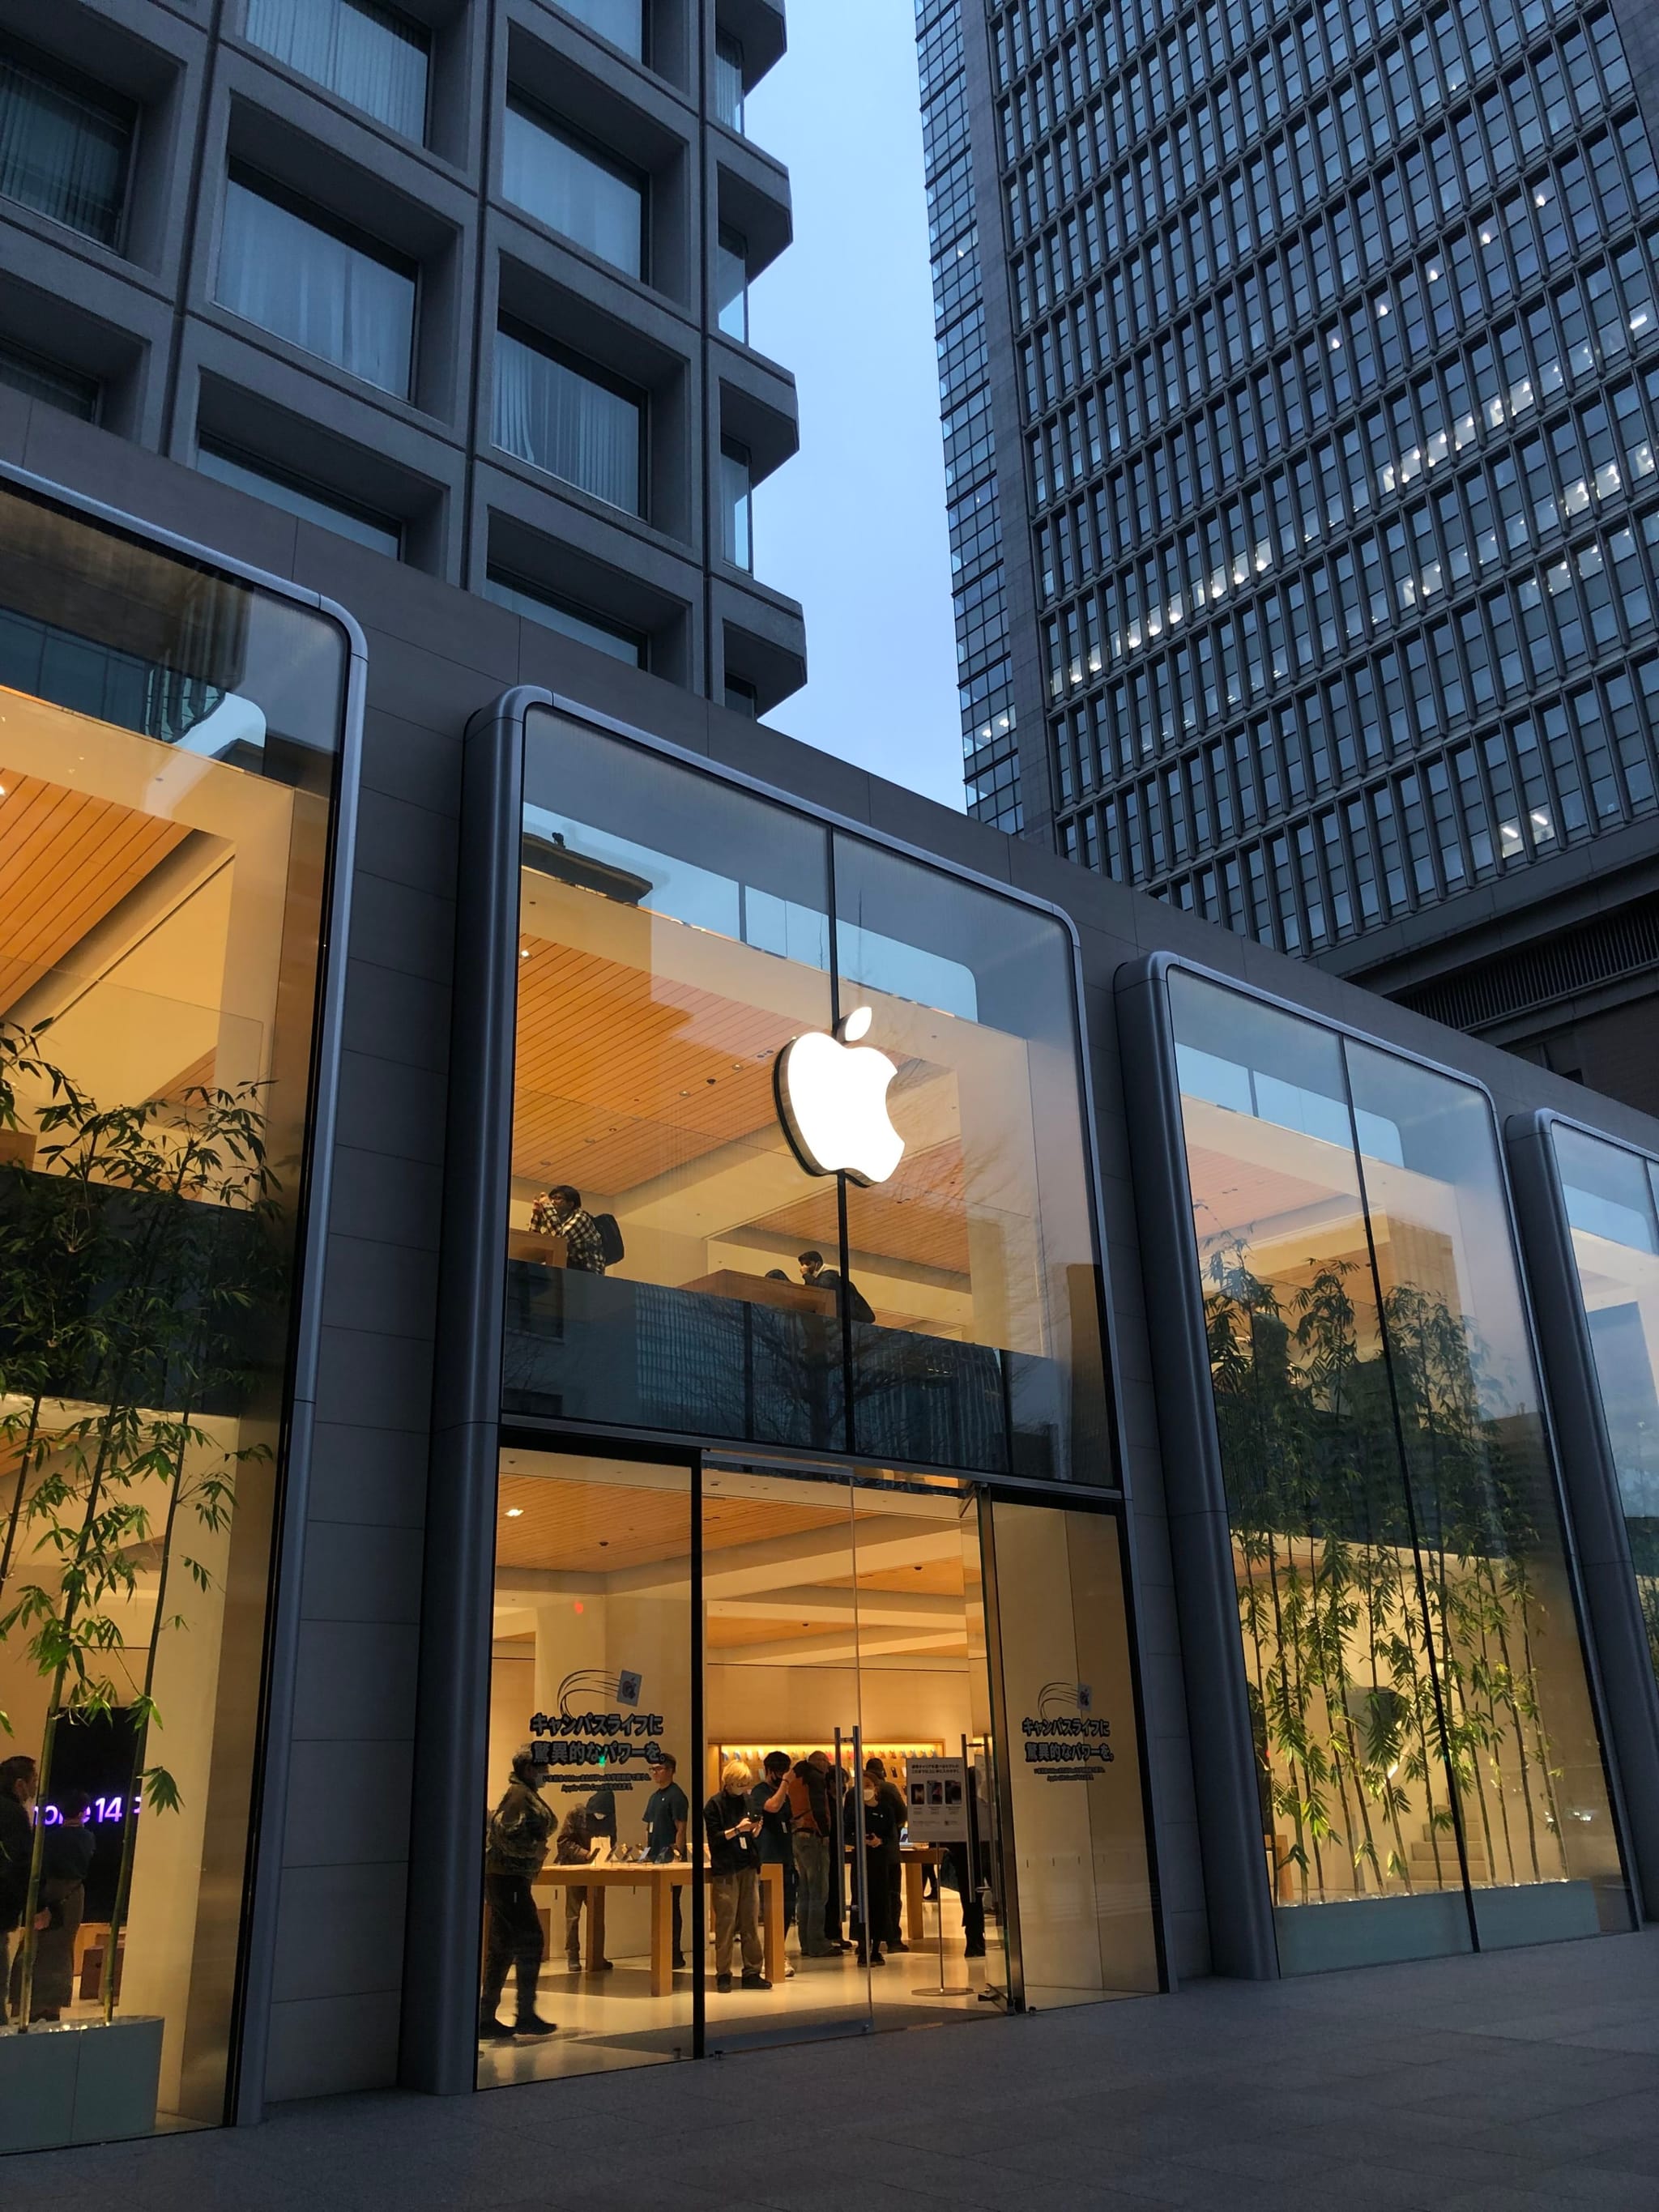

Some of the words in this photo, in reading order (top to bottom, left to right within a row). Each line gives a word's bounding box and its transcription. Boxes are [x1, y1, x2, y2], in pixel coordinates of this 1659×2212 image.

[531, 1712, 663, 1736] キャンパスライフに
[1022, 1717, 1111, 1737] キャンパスライフに
[531, 1741, 666, 1765] 驚異的なパワーを。
[95, 1796, 122, 1822] 14
